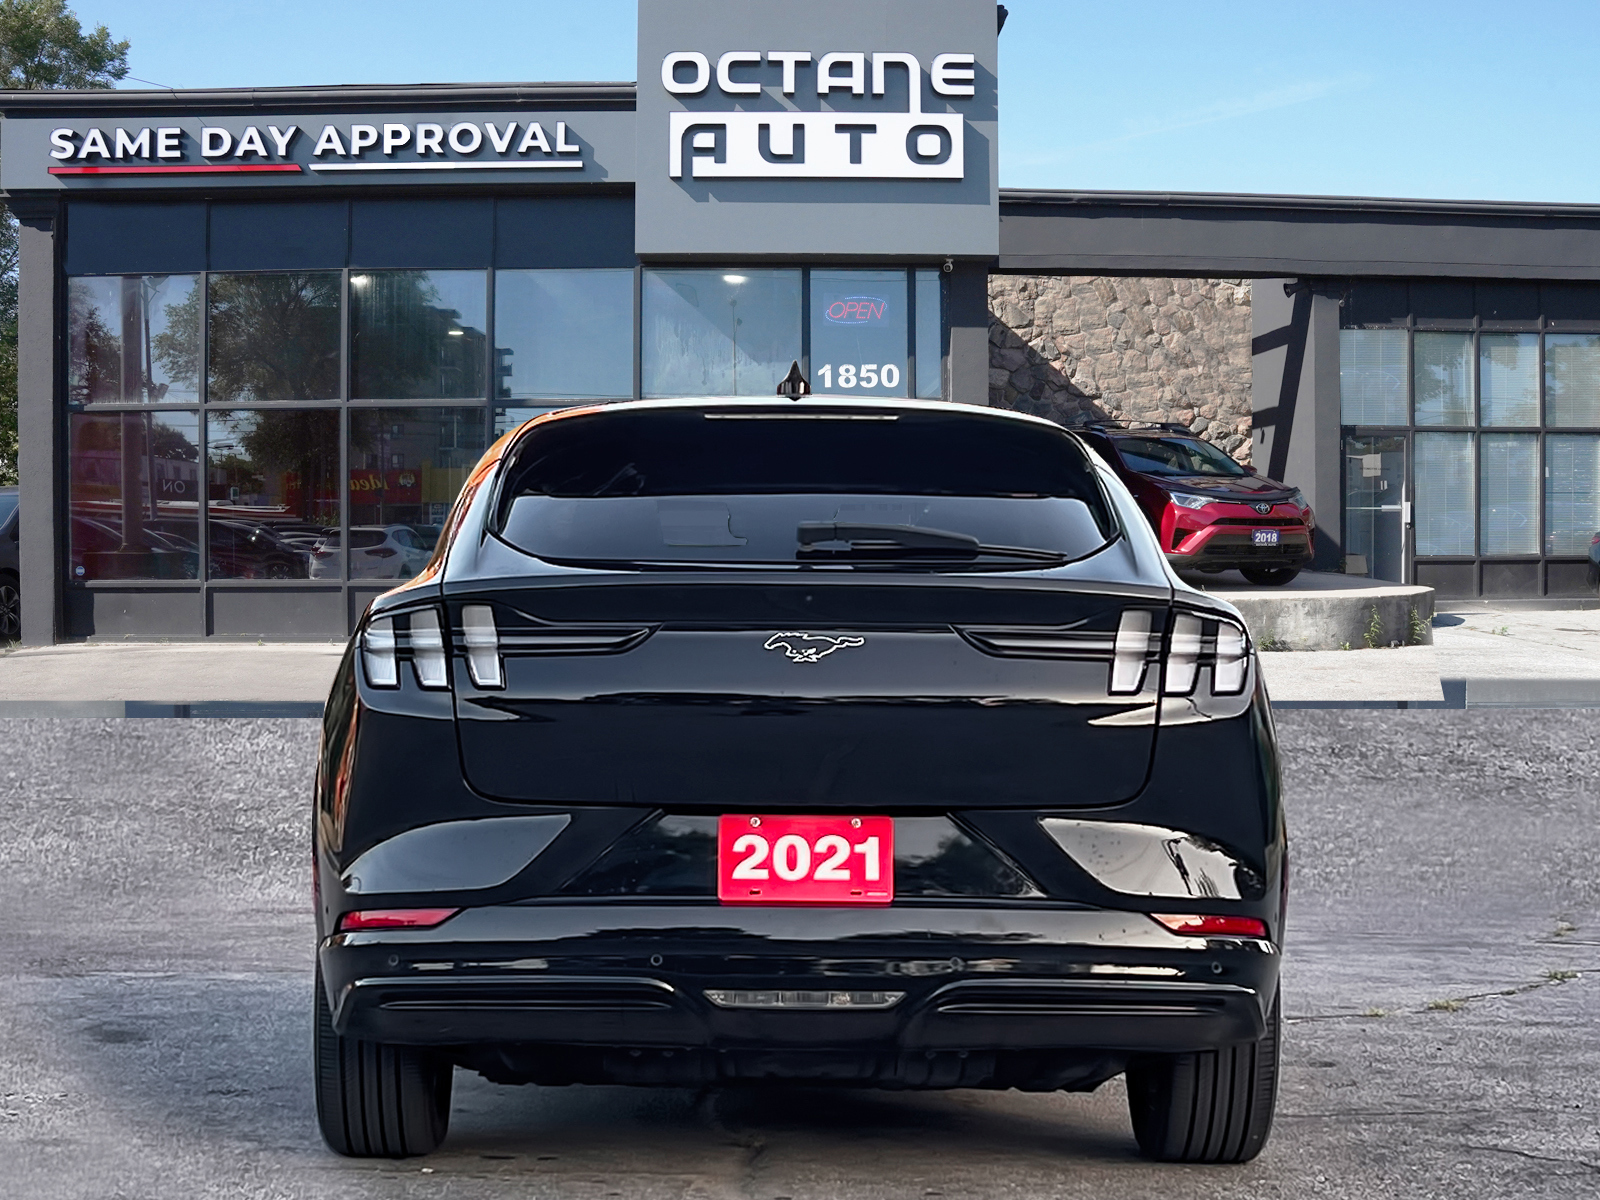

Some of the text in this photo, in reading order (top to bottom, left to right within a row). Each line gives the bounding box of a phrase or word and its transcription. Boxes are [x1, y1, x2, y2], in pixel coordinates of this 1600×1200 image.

[661, 51, 975, 112] OCTANE
[49, 120, 580, 161] SAME DAY APPROVAL
[681, 123, 953, 177] AUTO
[827, 301, 886, 320] OPEN
[817, 363, 900, 388] 1850
[1255, 532, 1278, 543] 2018
[732, 834, 880, 881] 2021
